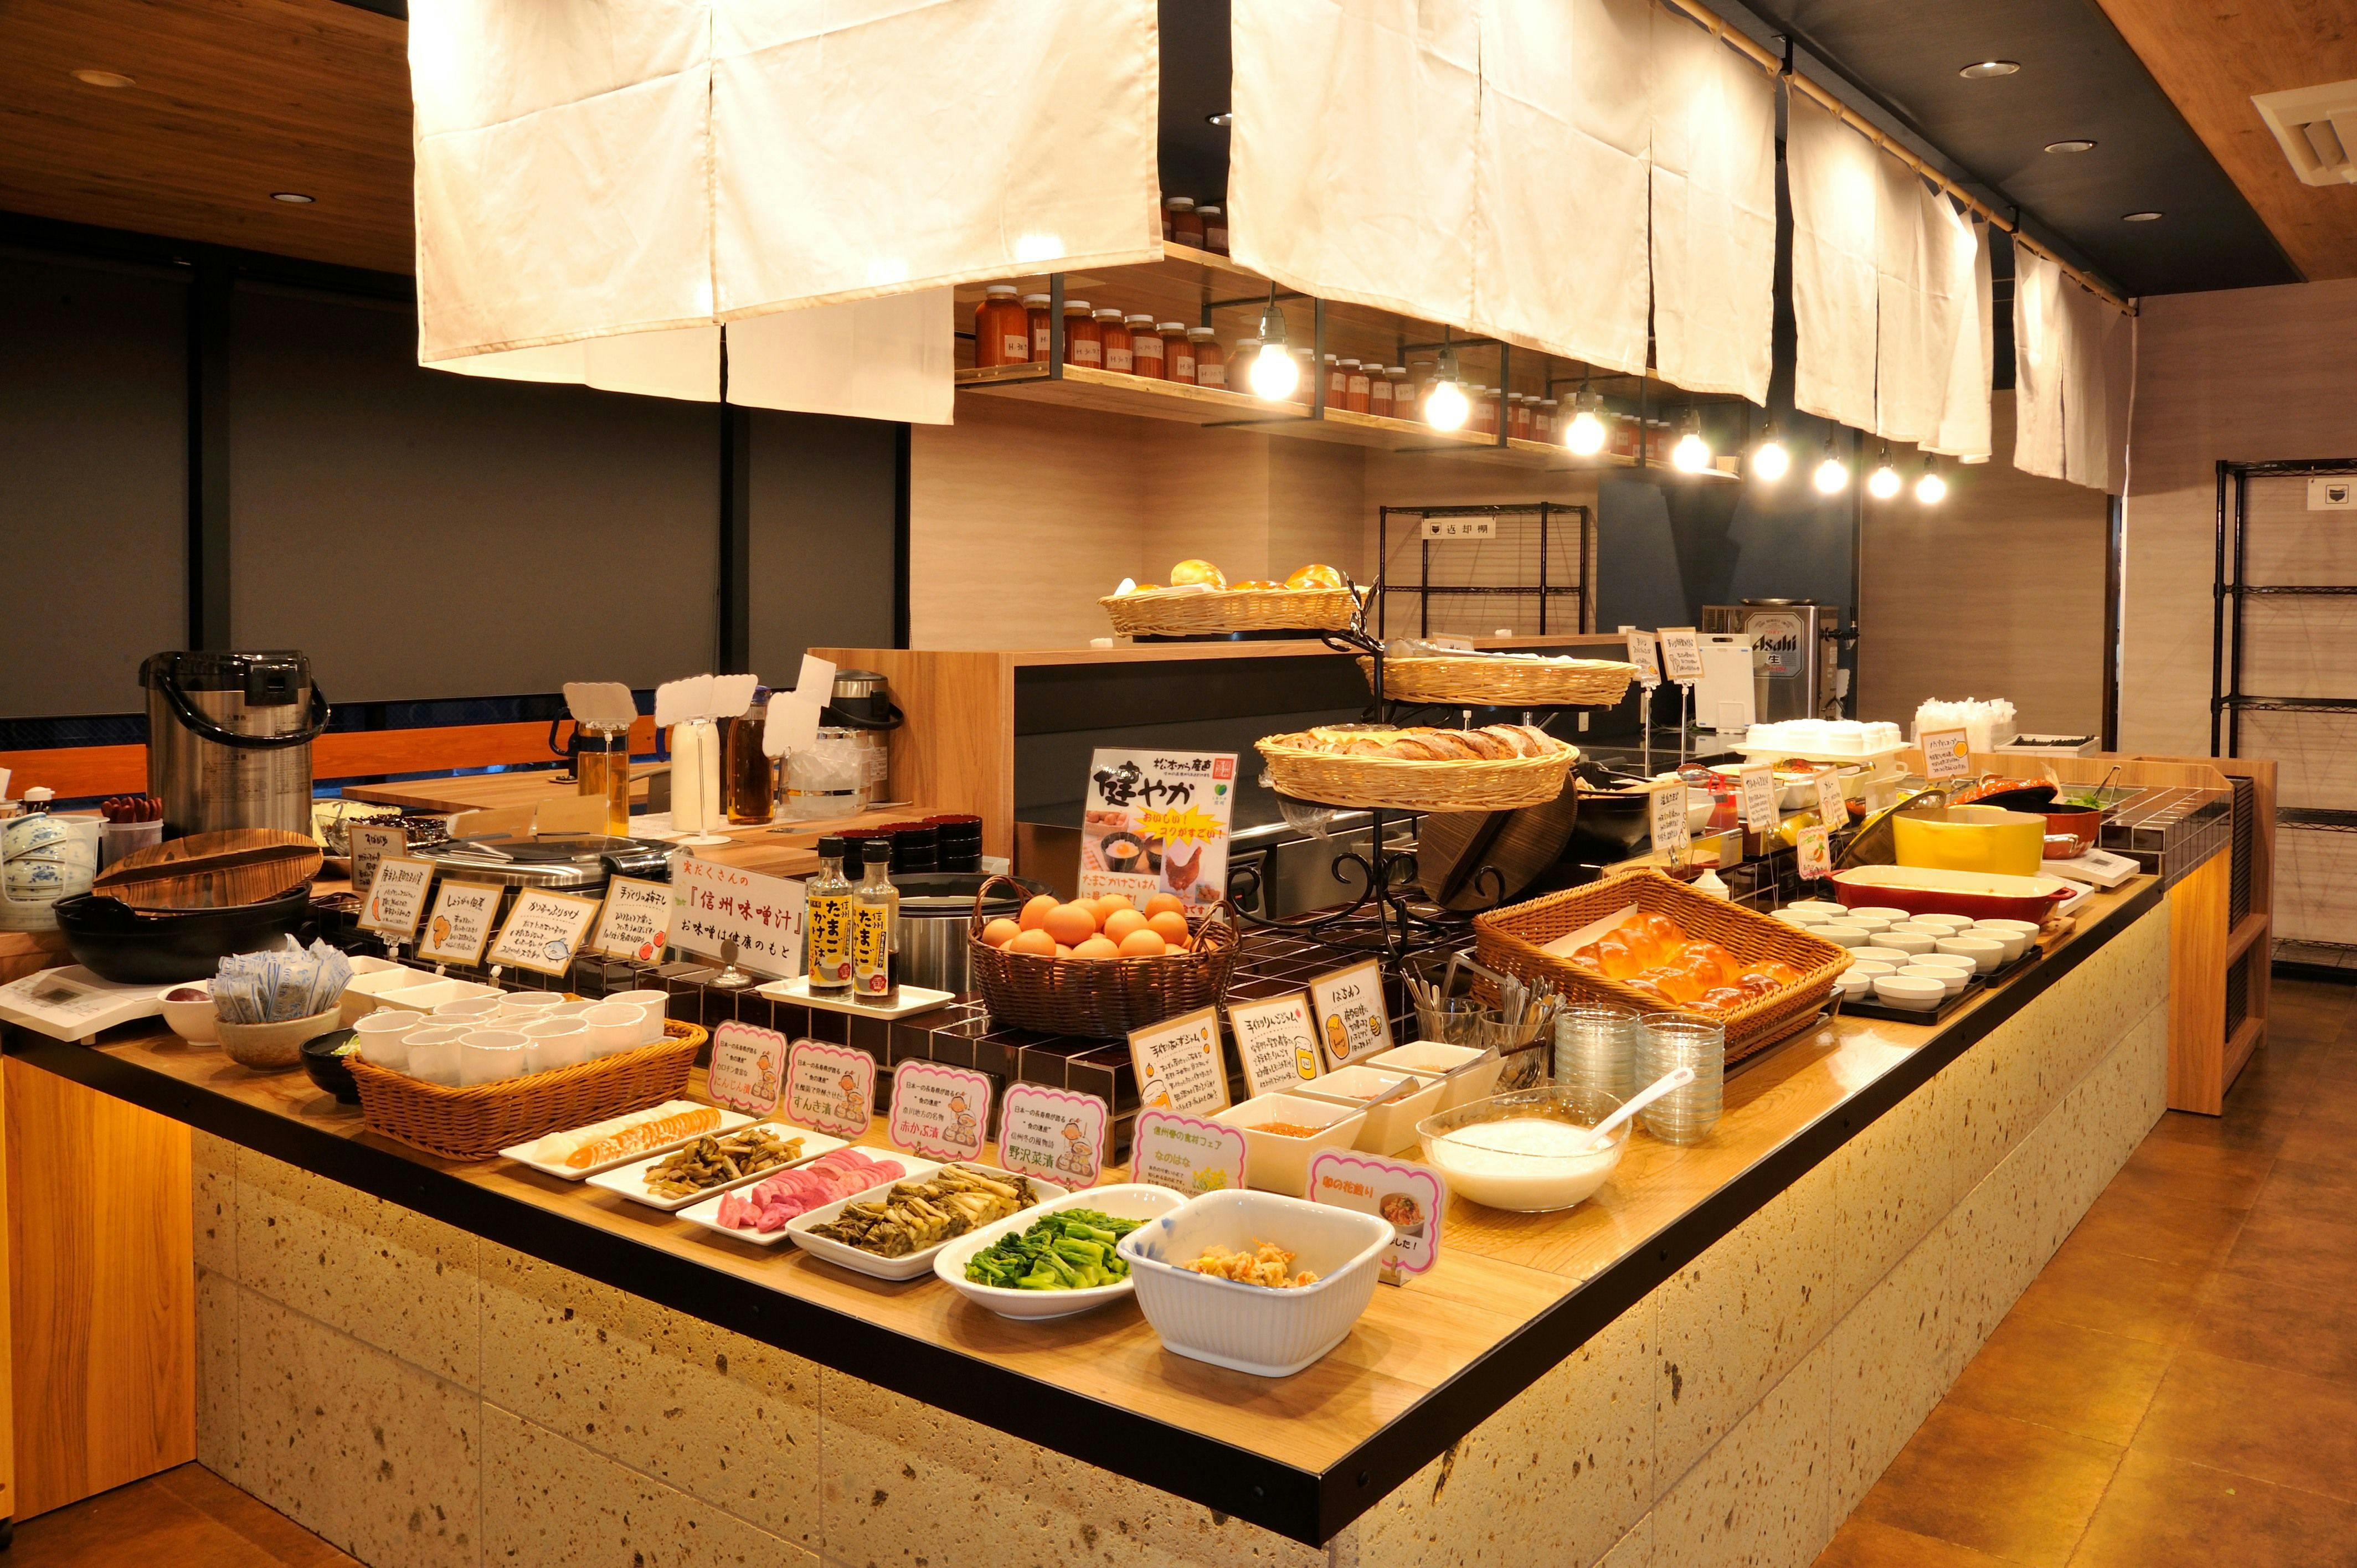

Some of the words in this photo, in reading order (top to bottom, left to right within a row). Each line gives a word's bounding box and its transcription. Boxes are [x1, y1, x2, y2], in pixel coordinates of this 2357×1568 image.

[1447, 524, 1488, 534] 返却棚
[1752, 635, 1797, 651] Asahi
[1768, 655, 1780, 663] 生
[1154, 758, 1212, 771] 松本から産直
[1093, 760, 1195, 807] 健やか
[683, 860, 748, 886] 実だくさんの
[1083, 874, 1156, 890] たまごかけごはん
[620, 886, 666, 905] 手づくりの梅干し
[528, 901, 580, 919] かつおのふりかけ
[691, 886, 801, 935] 『信州味噌汁』
[841, 900, 850, 918] 信州
[826, 900, 842, 953] たまご
[872, 911, 883, 929] 信州
[812, 911, 826, 967] かけごはん
[859, 910, 874, 963] たまご
[1333, 985, 1360, 1003] はちみつ
[1244, 1012, 1298, 1034] 手作りりんごジャム
[1150, 1033, 1200, 1058] 手作りあんずジャム
[714, 1076, 752, 1095] にんじん漬
[794, 1095, 831, 1116] すんき漬
[900, 1120, 939, 1139] 赤かぶ漬
[1154, 1126, 1222, 1150] 信州春の食材フェア
[1008, 1145, 1054, 1169] 野沢菜漬
[1155, 1150, 1191, 1168] なのはな
